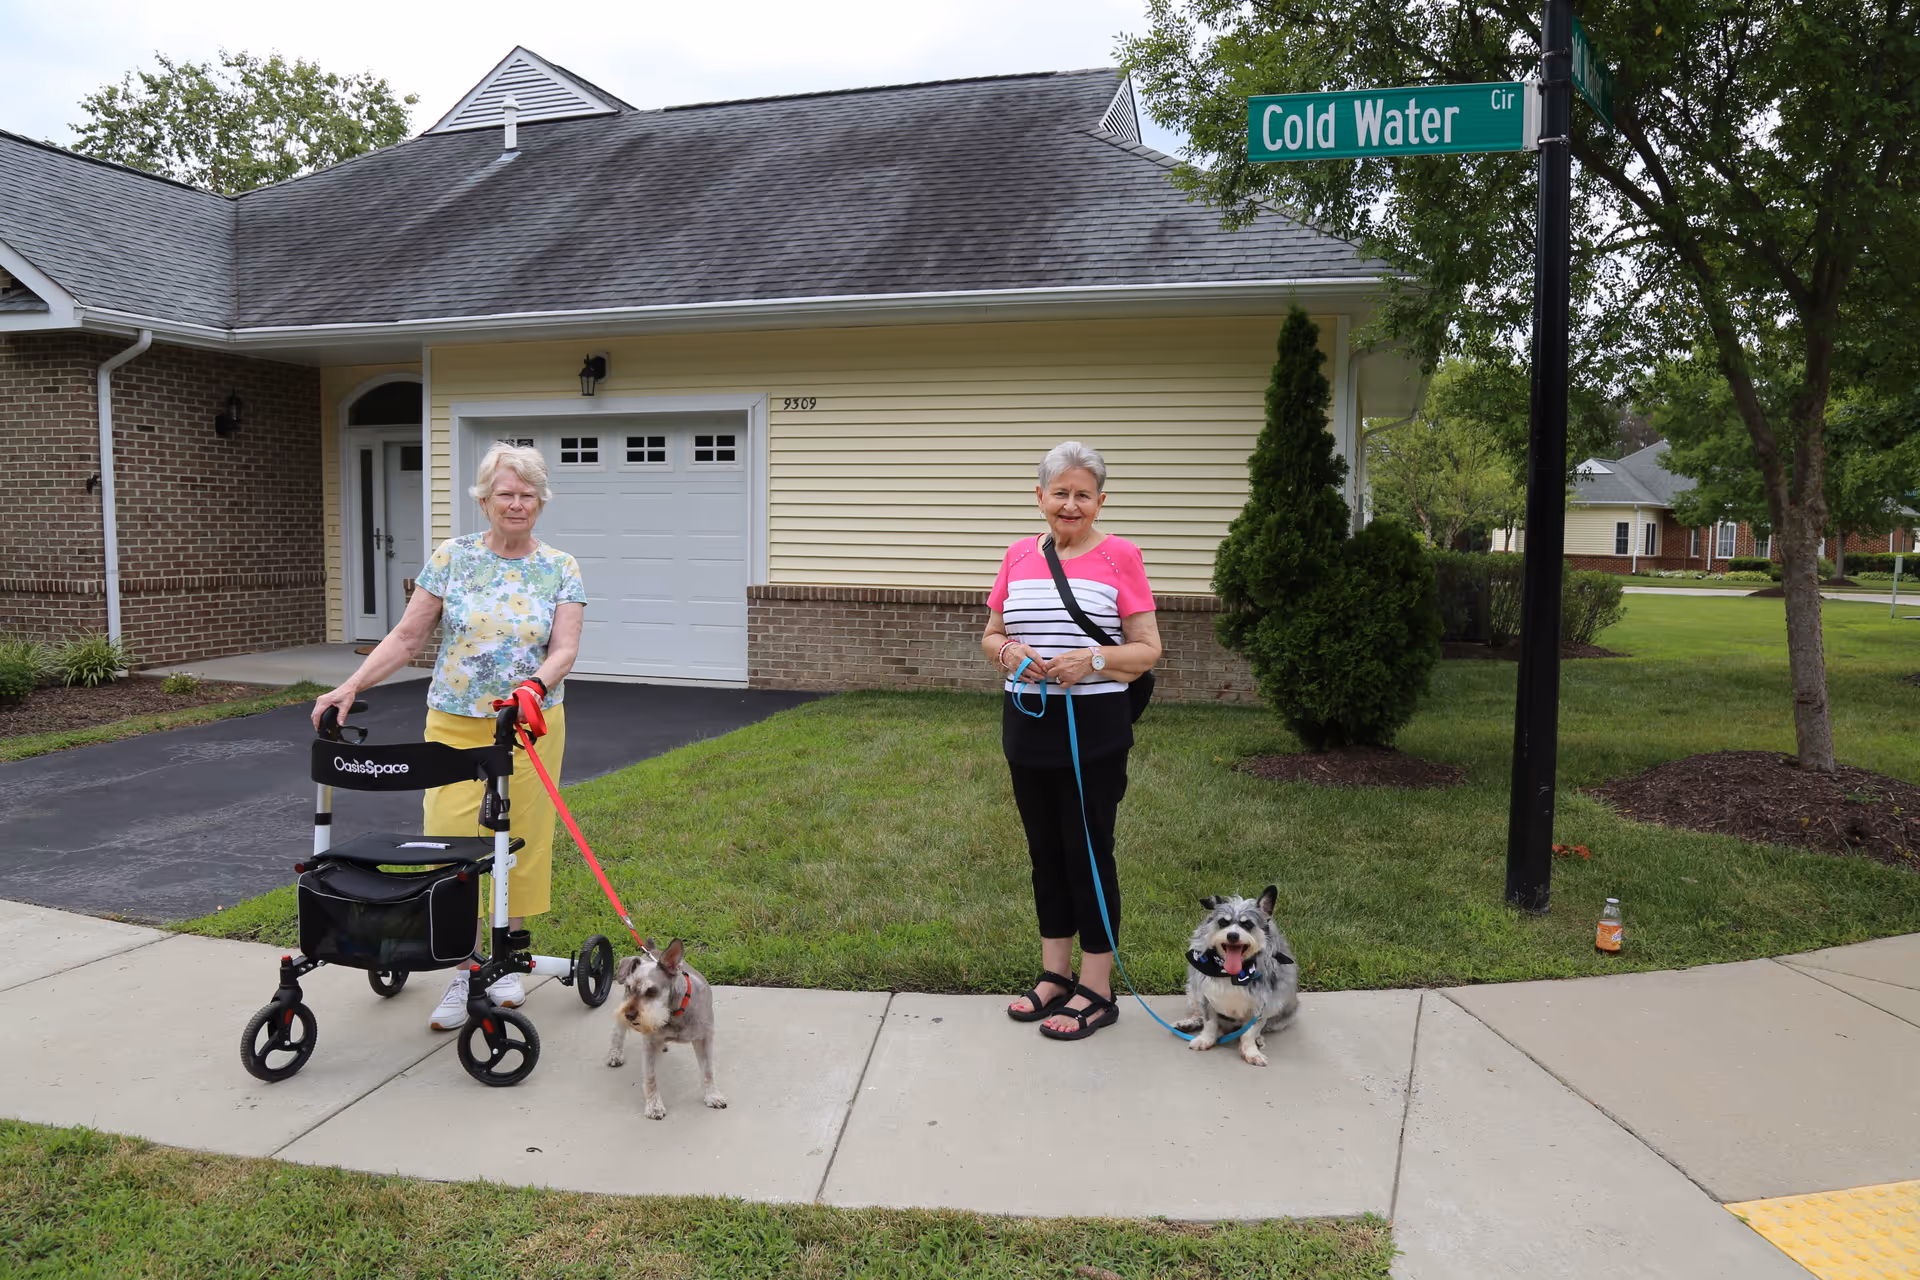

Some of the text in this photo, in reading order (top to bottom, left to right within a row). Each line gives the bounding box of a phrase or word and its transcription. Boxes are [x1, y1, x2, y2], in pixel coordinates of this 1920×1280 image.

[1262, 90, 1515, 151] Cold Water Cir
[784, 397, 817, 410] 9309
[334, 756, 409, 778] OasisSpace
